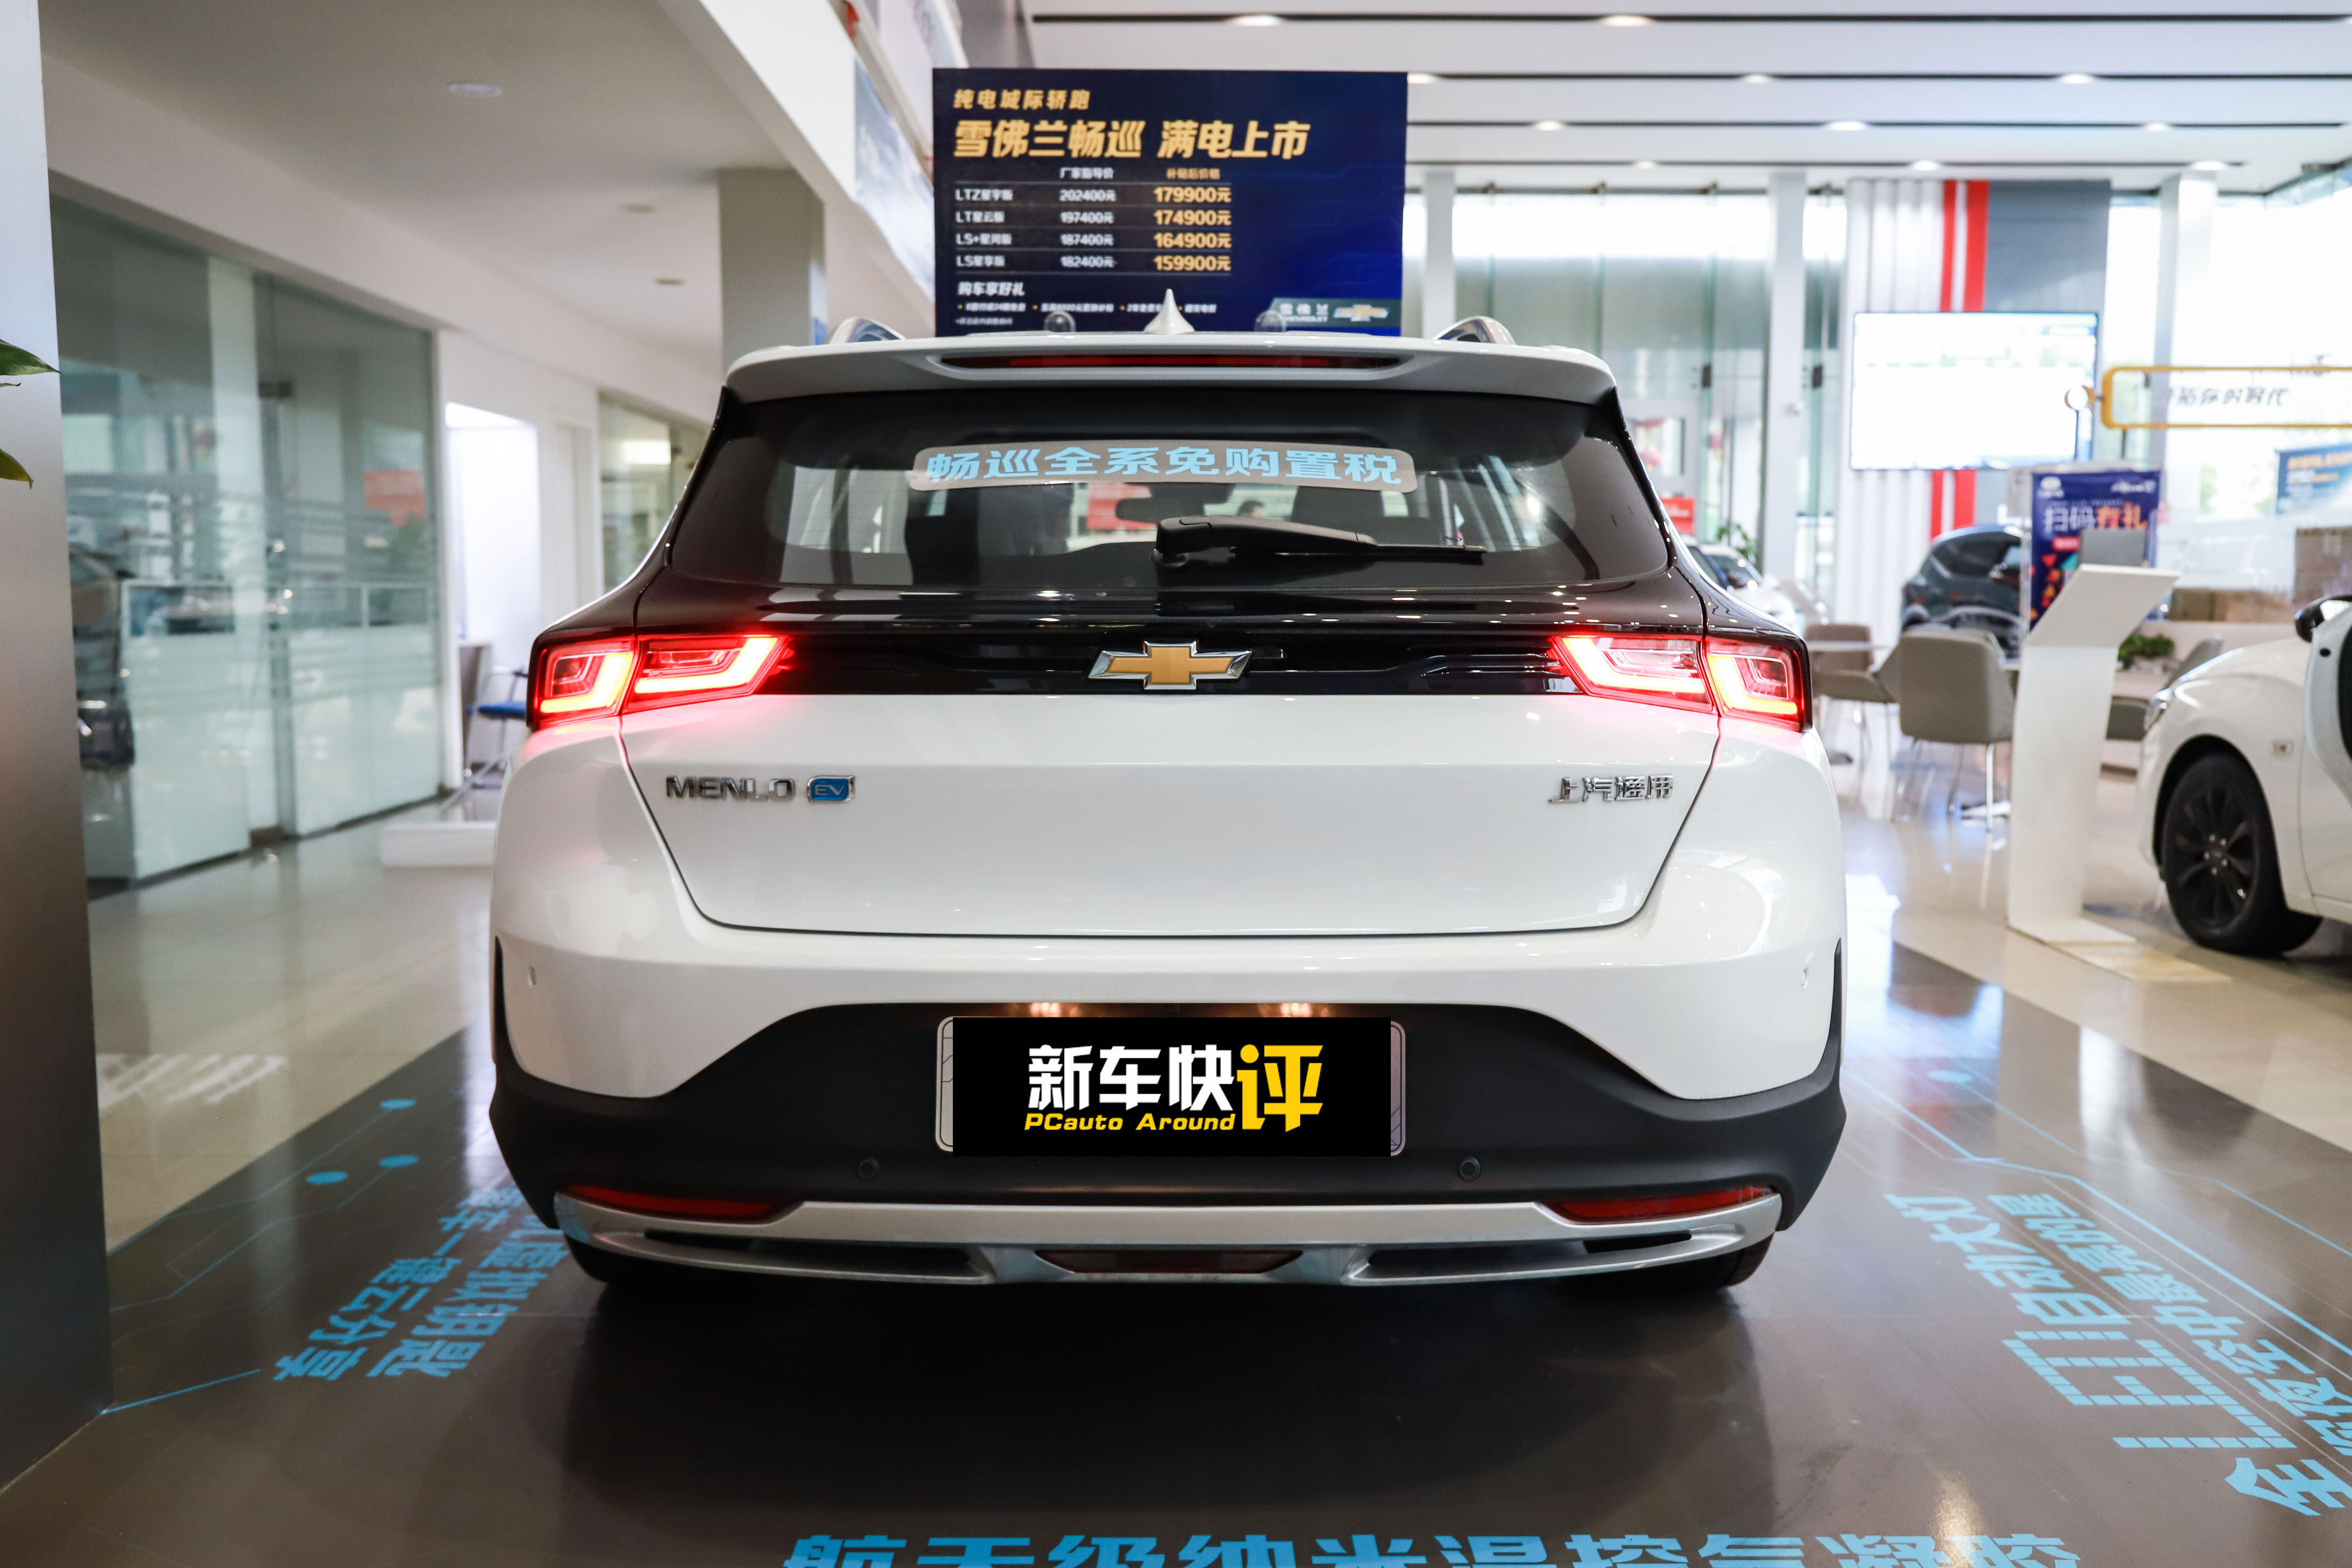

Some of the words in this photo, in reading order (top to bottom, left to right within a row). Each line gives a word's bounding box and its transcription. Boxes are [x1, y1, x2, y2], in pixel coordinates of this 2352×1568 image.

[954, 89, 1090, 110] 纯电城际轿跑
[954, 120, 1145, 158] 雪佛兰畅巡
[1158, 120, 1311, 159] 满电上市
[1060, 167, 1114, 179] 厂家指导价
[1060, 189, 1116, 202] 202400元
[1154, 187, 1231, 203] 179900元
[1060, 211, 1113, 224] 197400元
[1154, 210, 1231, 225] 174900元
[1060, 233, 1114, 246] 187400元
[1154, 233, 1231, 248] 164900元
[1060, 256, 1114, 268] 182400元
[1154, 256, 1231, 271] 159900元
[926, 446, 1402, 485] 畅巡全系免购置税
[666, 776, 795, 800] MENLO
[815, 784, 844, 795] EV
[1548, 775, 1673, 803] 上汽通用
